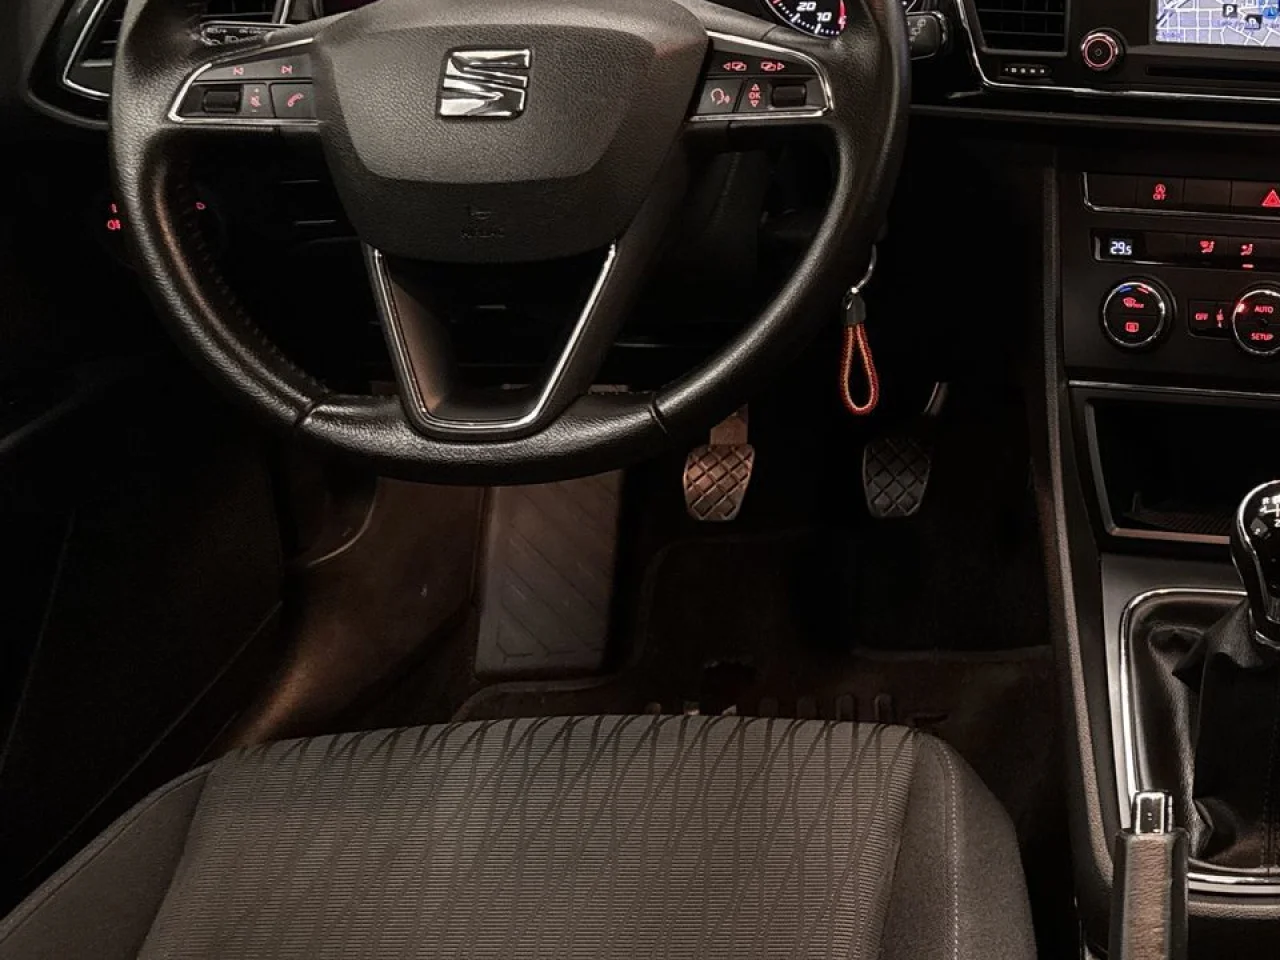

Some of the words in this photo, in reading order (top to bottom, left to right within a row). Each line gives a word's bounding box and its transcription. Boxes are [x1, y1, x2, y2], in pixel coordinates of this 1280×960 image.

[796, 1, 817, 11] 20
[816, 11, 832, 22] 10
[748, 91, 761, 100] OK
[1254, 305, 1274, 314] AUTO
[1195, 312, 1209, 321] OFF
[1251, 332, 1274, 341] SETUP
